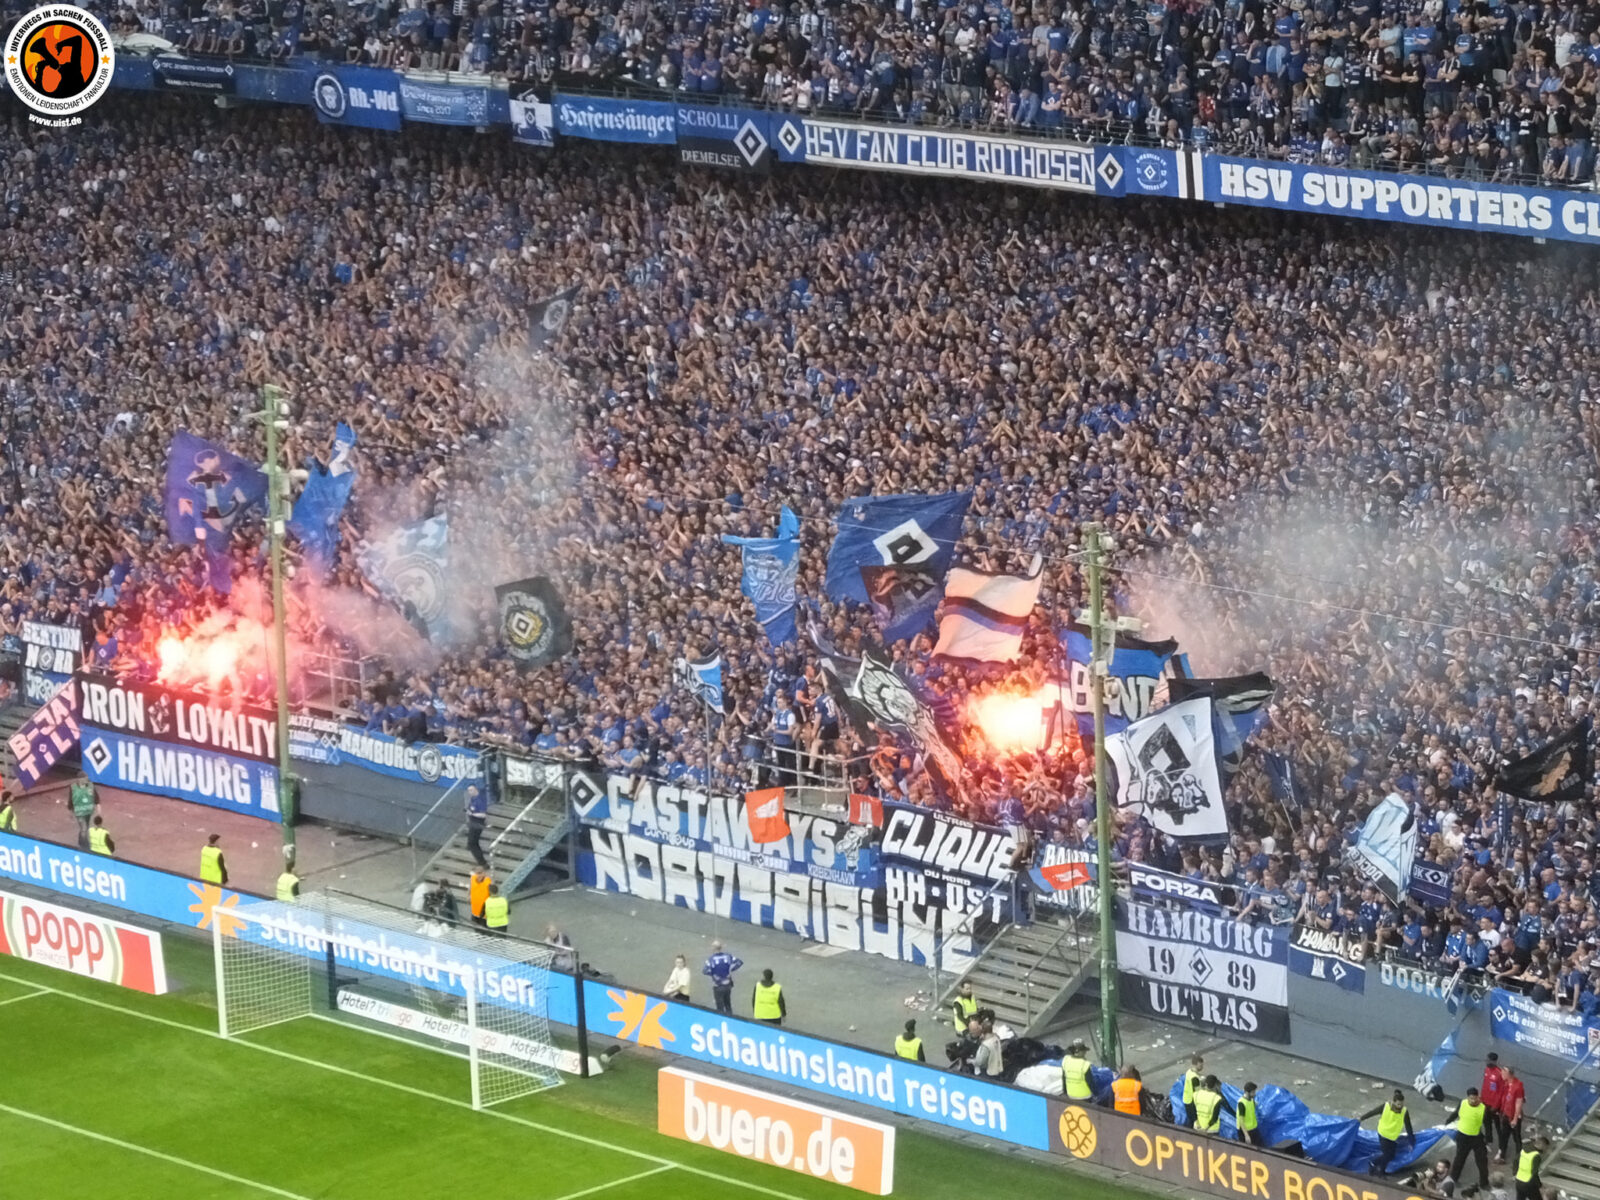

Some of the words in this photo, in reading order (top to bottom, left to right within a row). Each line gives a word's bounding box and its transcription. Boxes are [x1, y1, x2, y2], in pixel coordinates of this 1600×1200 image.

[559, 104, 675, 138] Hafensänger
[678, 108, 738, 131] SCHOLLI
[681, 149, 742, 168] DIEMELSEE
[804, 124, 848, 159] HSV
[856, 130, 898, 163] FAN
[906, 135, 968, 172] CLUB
[974, 141, 1095, 185] ROTHOSEN
[1219, 163, 1292, 202] HSV
[1302, 173, 1553, 230] SUPPORTERS
[8, 680, 78, 761] B-JAY
[81, 681, 145, 731] IRON
[175, 699, 277, 758] LOYALTY
[117, 740, 252, 805] HAMBURG
[881, 810, 1018, 880] CLIQUE
[48, 855, 127, 901] reisen
[1130, 870, 1219, 904] FORZA
[1127, 901, 1274, 958] HAMBURG
[1147, 945, 1175, 975] 19
[1227, 960, 1257, 992] 89
[341, 992, 377, 1013] Hotel?
[422, 1016, 459, 1034] Hotel?
[1148, 981, 1259, 1033] ULTRAS
[1506, 1009, 1519, 1025] ich
[1521, 1017, 1536, 1029] ein
[1508, 995, 1536, 1014] Danke
[1515, 1031, 1557, 1051] geworden
[690, 1021, 895, 1103] schauinsland
[904, 1076, 1007, 1133] reisen
[683, 1079, 856, 1184] buero.de
[1125, 1128, 1271, 1200] OPTIKER
[1284, 1169, 1379, 1200] BOD
